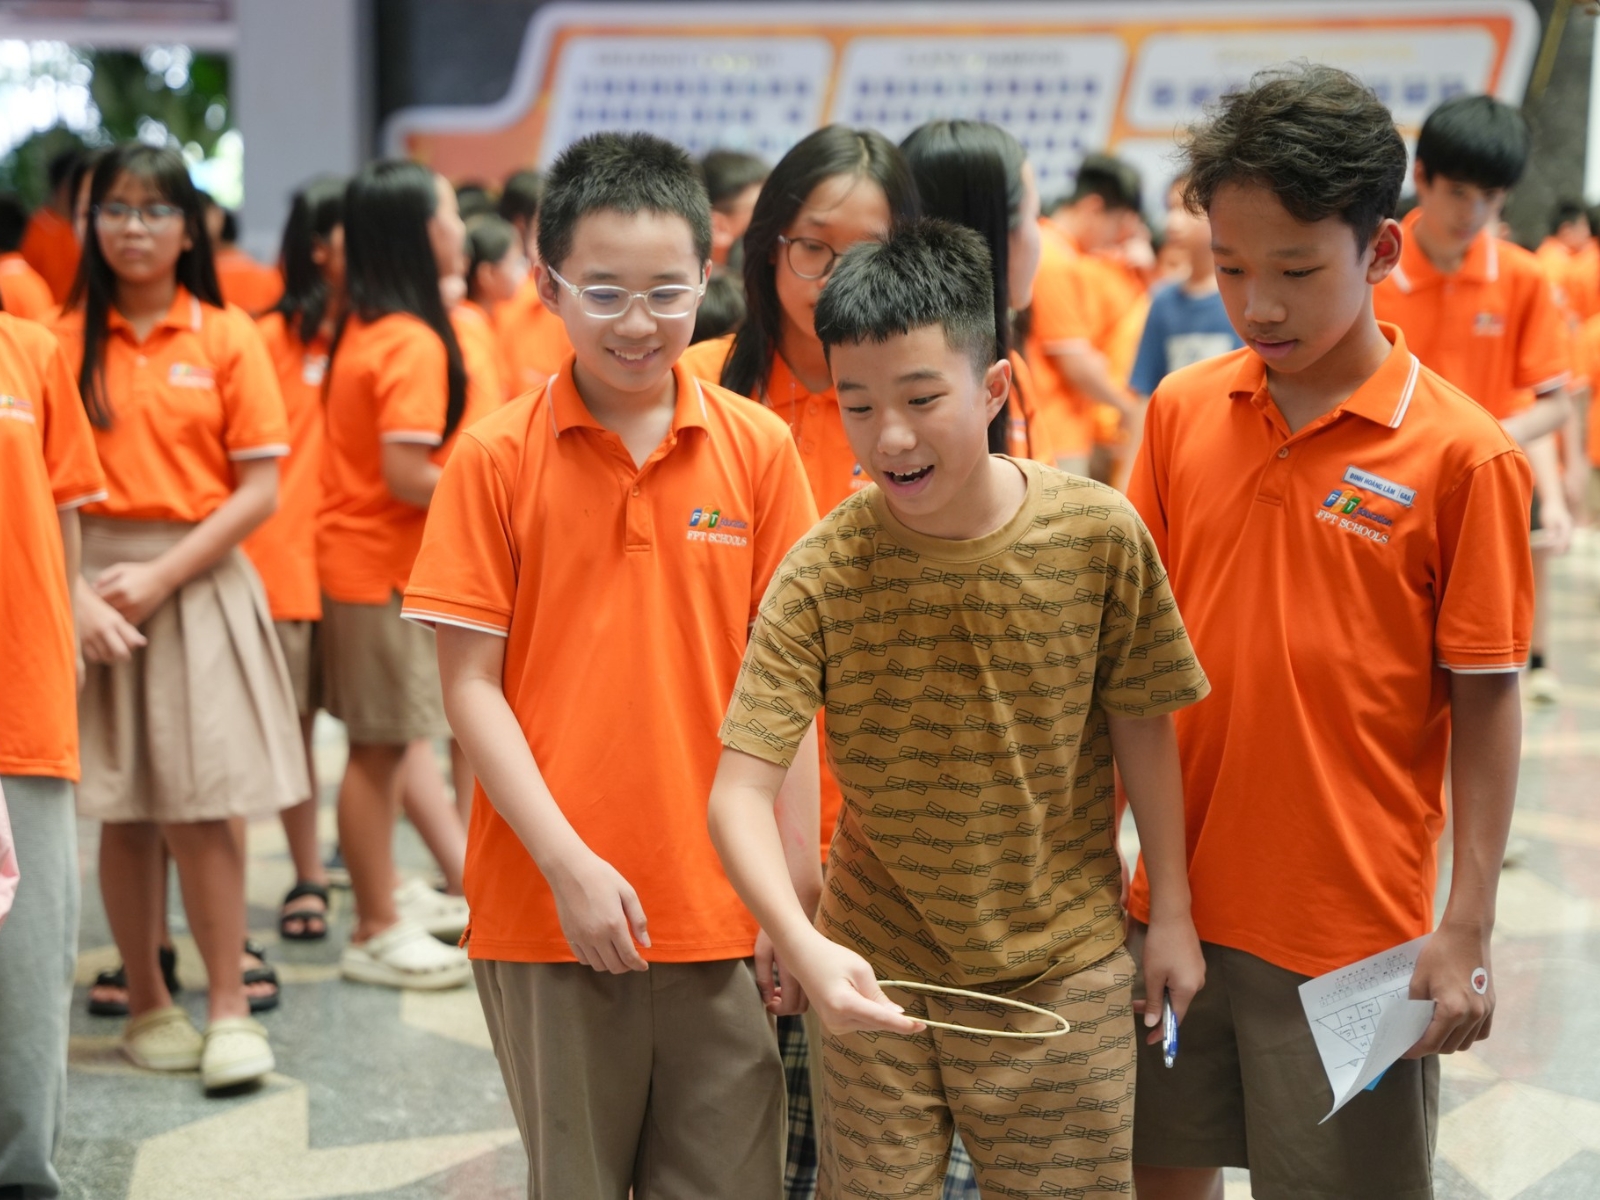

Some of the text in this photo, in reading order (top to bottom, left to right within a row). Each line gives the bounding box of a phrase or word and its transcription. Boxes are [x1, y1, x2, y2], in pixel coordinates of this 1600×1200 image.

[1325, 491, 1358, 512] FPT
[690, 509, 719, 526] FPT
[1316, 509, 1389, 544] FPT SCHOOLS
[686, 530, 748, 547] FPT SCHOOLS
